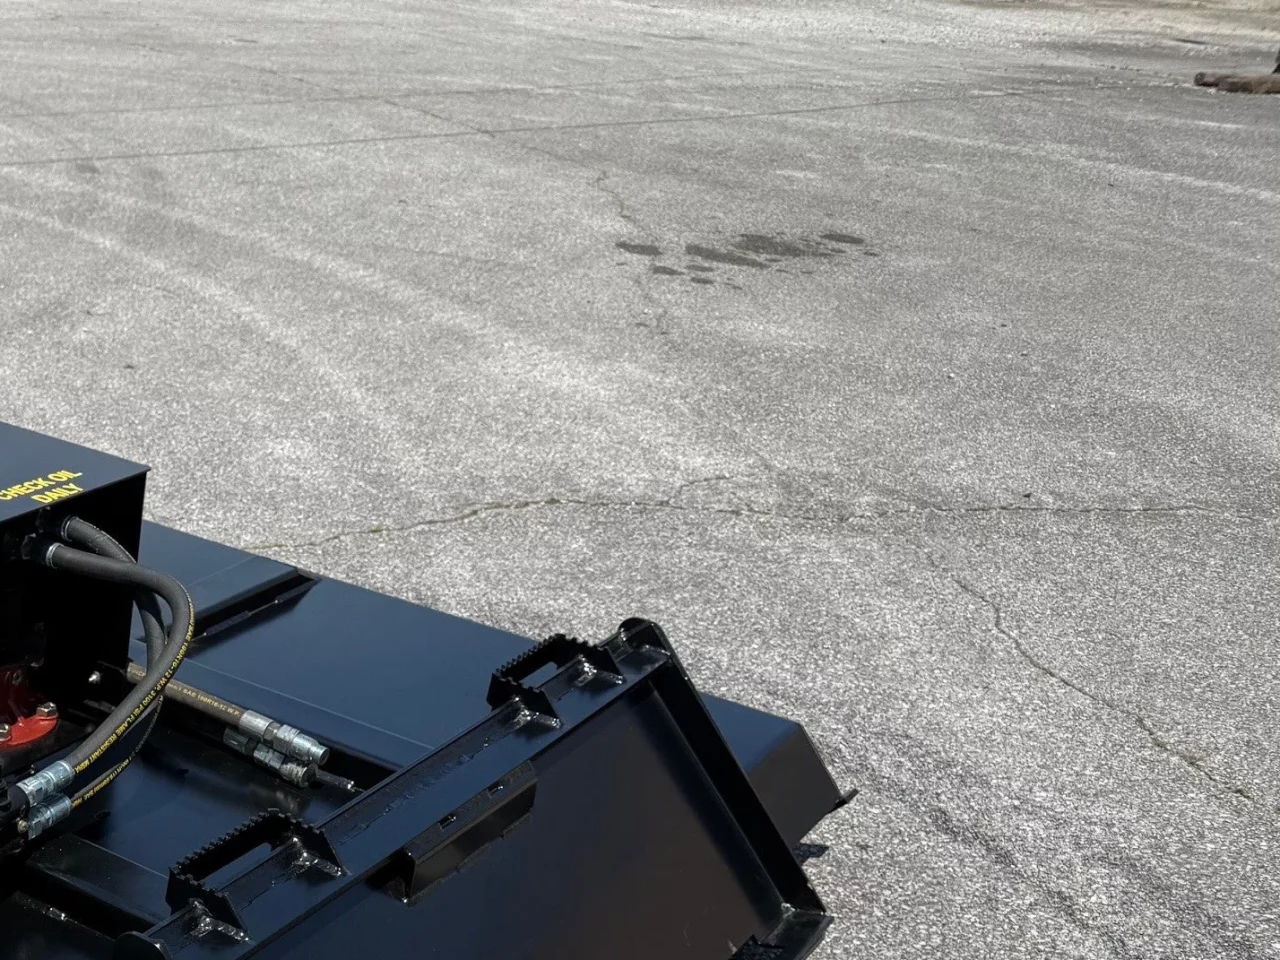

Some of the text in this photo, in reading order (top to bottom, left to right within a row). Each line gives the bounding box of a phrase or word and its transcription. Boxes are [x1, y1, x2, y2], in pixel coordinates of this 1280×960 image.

[47, 469, 83, 482] OIL
[30, 482, 83, 504] DAILY
[142, 690, 157, 706] 3100
[133, 703, 145, 717] PSI
[115, 714, 136, 737] FLAME
[89, 733, 118, 763] RESISTANT
